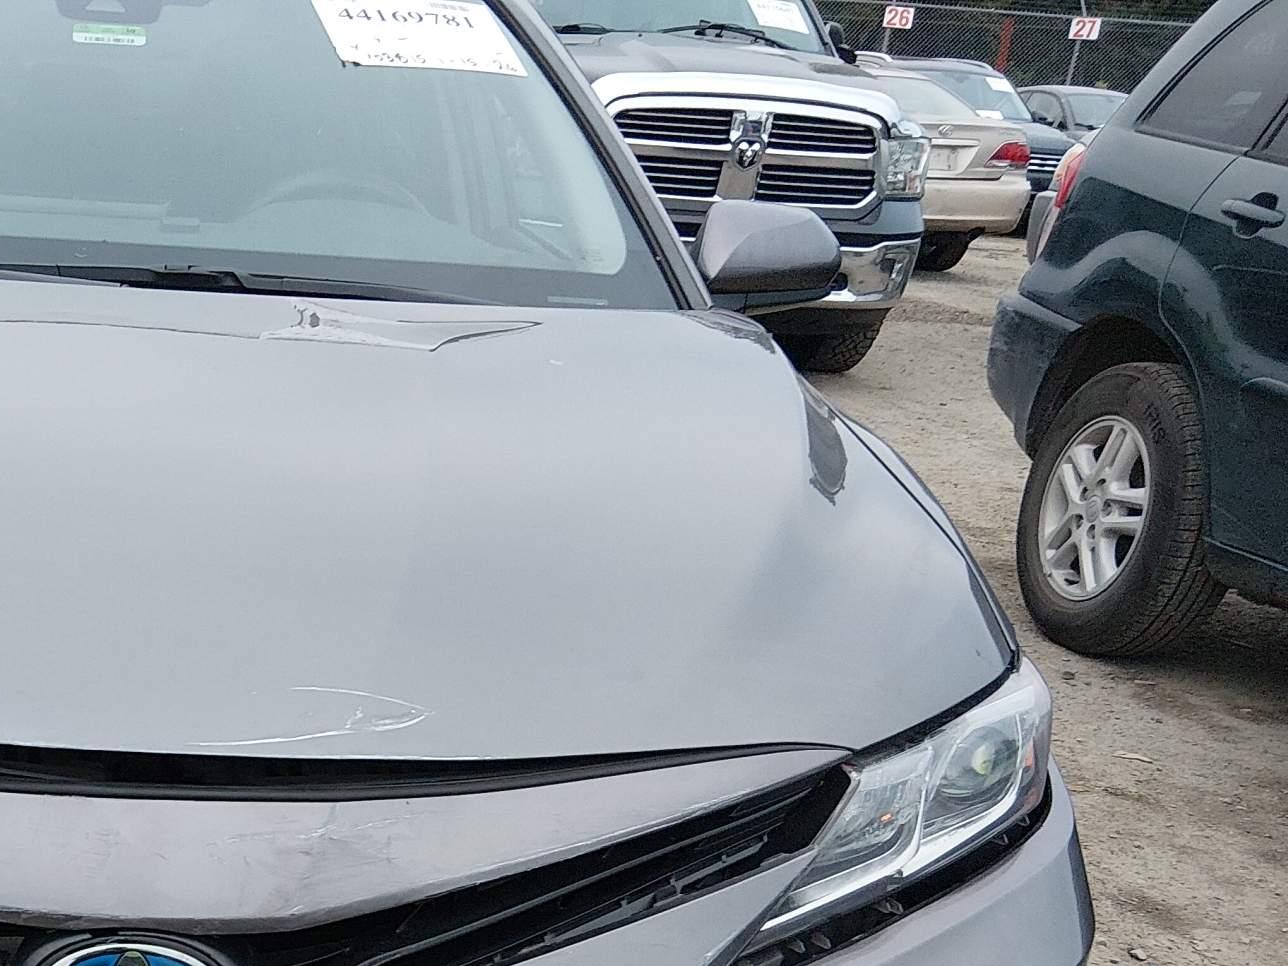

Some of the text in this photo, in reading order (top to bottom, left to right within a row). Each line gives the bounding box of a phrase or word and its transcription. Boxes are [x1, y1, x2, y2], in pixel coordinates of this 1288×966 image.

[338, 8, 474, 28] 44169781
[885, 8, 910, 27] 26
[1072, 19, 1097, 38] 27
